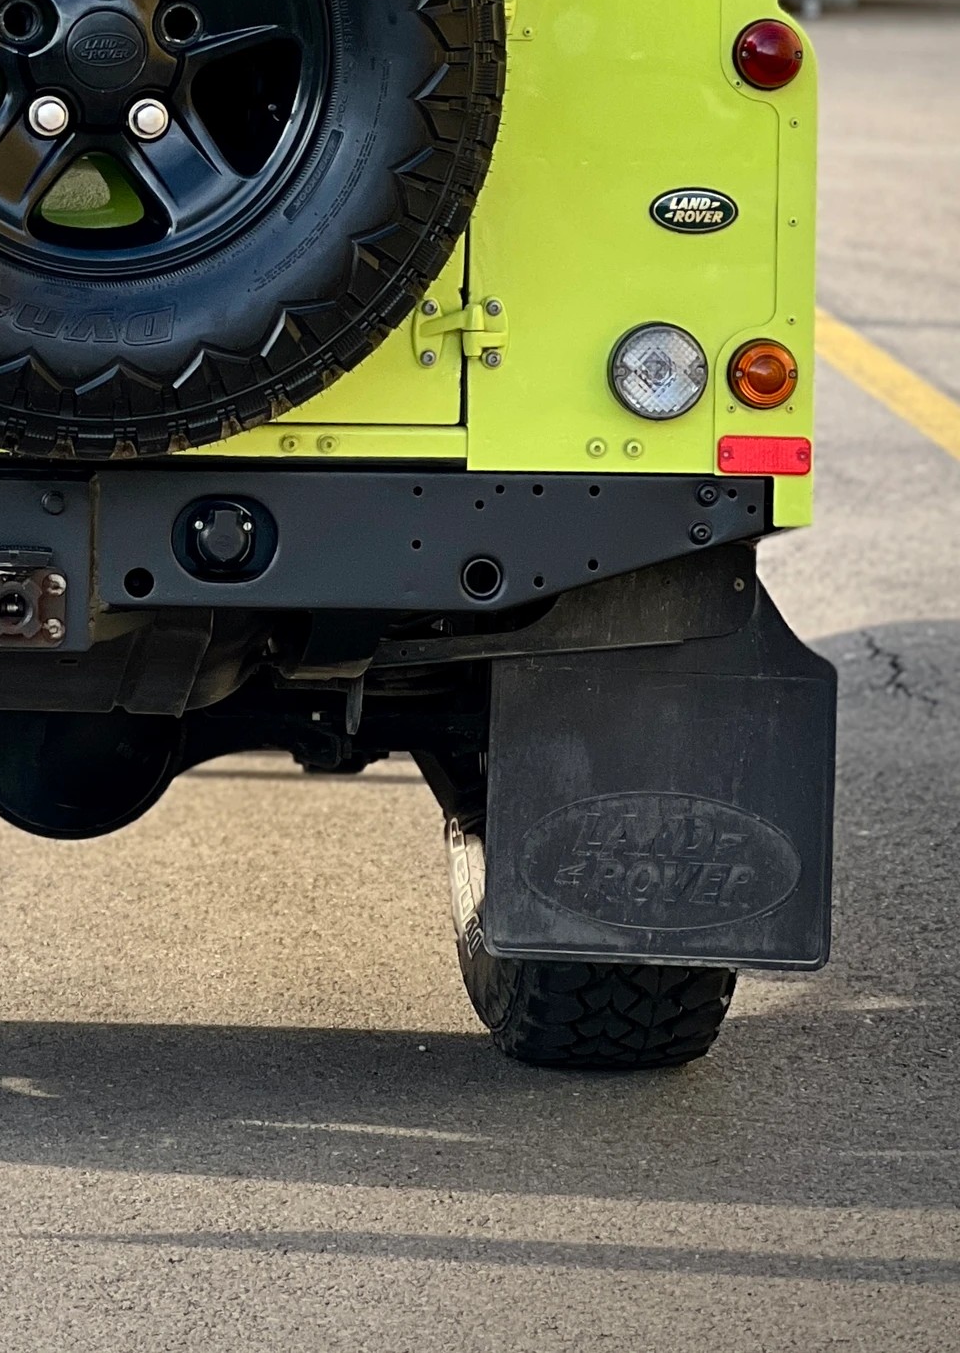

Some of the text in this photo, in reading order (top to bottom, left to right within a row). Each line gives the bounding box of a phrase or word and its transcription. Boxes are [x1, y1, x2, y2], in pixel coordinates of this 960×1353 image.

[84, 39, 118, 49] LAND
[88, 49, 129, 60] ROVER
[670, 197, 711, 210] LAND
[673, 210, 724, 224] ROVER
[572, 812, 717, 857] LAND
[593, 858, 756, 904] ROVER
